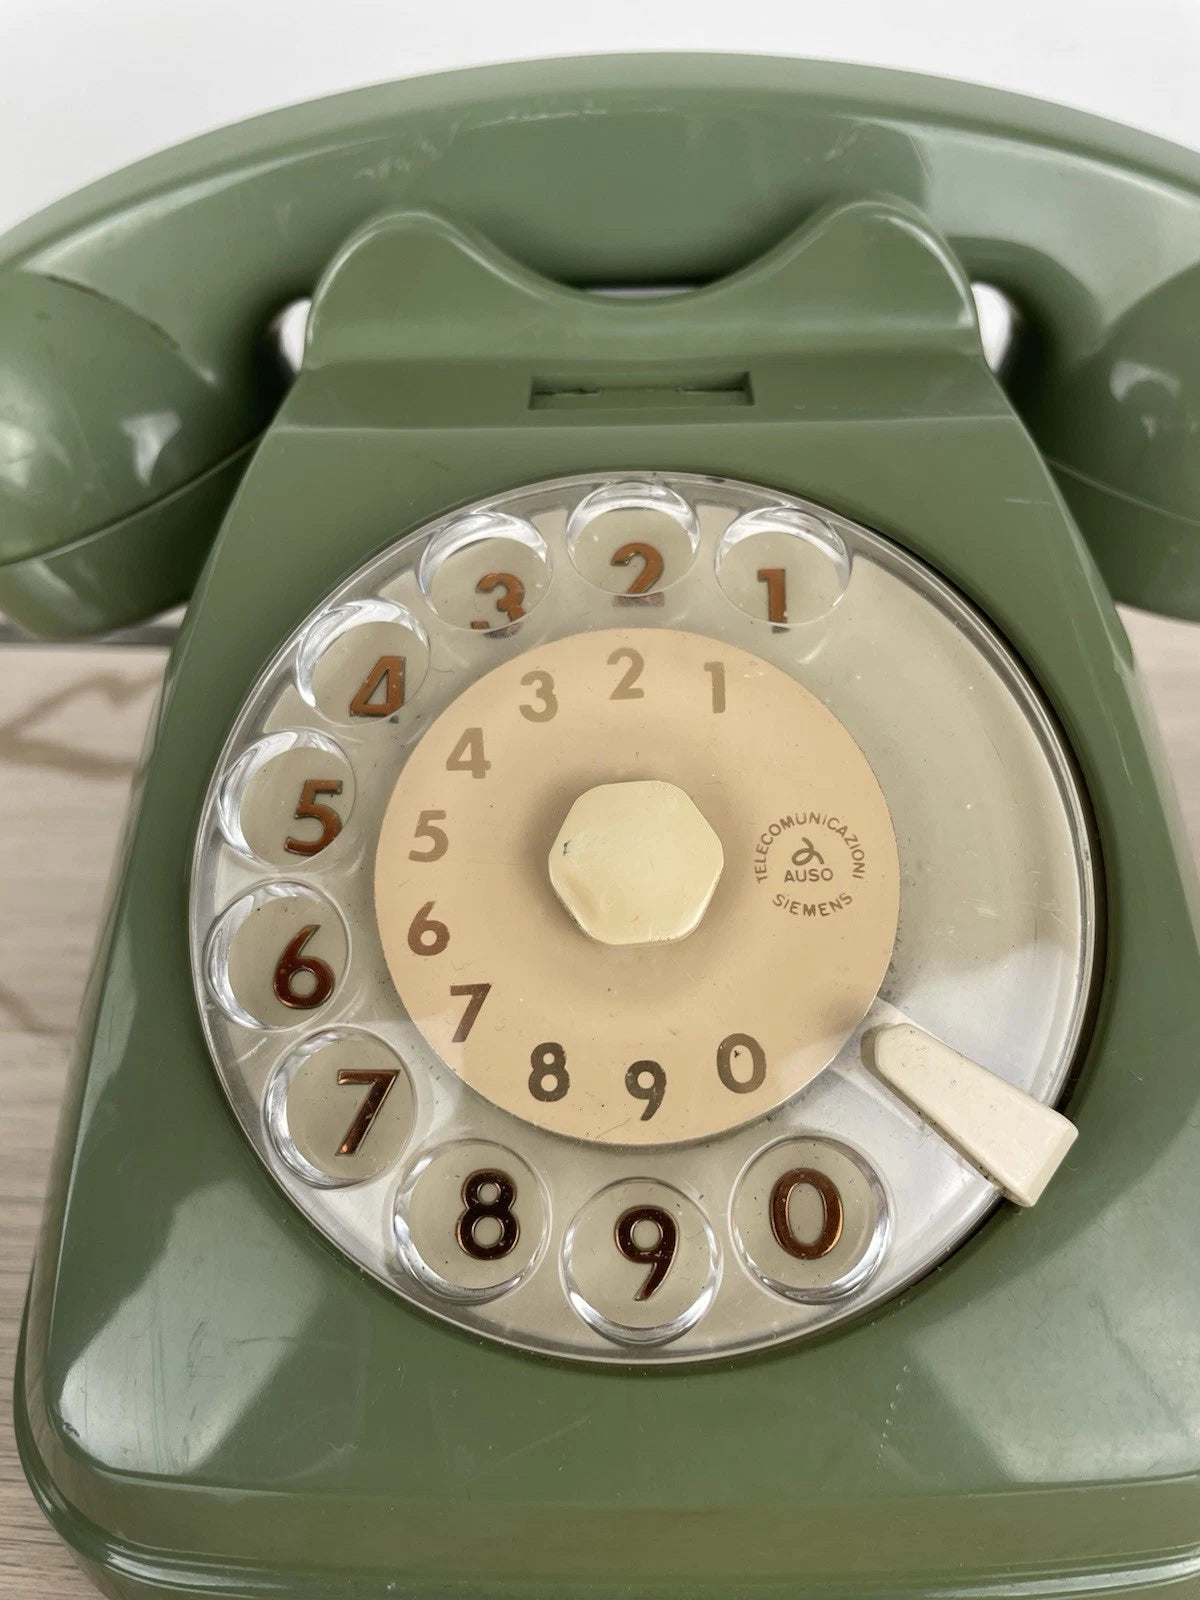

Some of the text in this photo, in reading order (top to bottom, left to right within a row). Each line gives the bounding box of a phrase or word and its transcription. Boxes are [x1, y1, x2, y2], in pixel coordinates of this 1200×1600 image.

[471, 572, 526, 634] 3
[611, 542, 665, 605] 2
[757, 568, 788, 631] 1
[350, 655, 407, 719] 4
[519, 670, 558, 723] 3
[607, 647, 645, 700] 2
[704, 662, 726, 714] 1
[446, 727, 491, 779] 4
[284, 779, 344, 857] 5
[408, 809, 449, 863] 5
[754, 812, 866, 884] TELECOMUNICAZIONI
[772, 892, 853, 917] SIEMENS
[784, 868, 834, 882] AUSO
[407, 901, 451, 956] 6
[273, 924, 336, 1010] 6
[450, 983, 492, 1043] 7
[528, 1042, 570, 1102] 8
[624, 1060, 667, 1121] 9
[716, 1033, 766, 1094] 0
[335, 1069, 401, 1156] 7
[456, 1168, 521, 1261] 8
[769, 1167, 845, 1260] 0
[614, 1204, 679, 1301] 9
